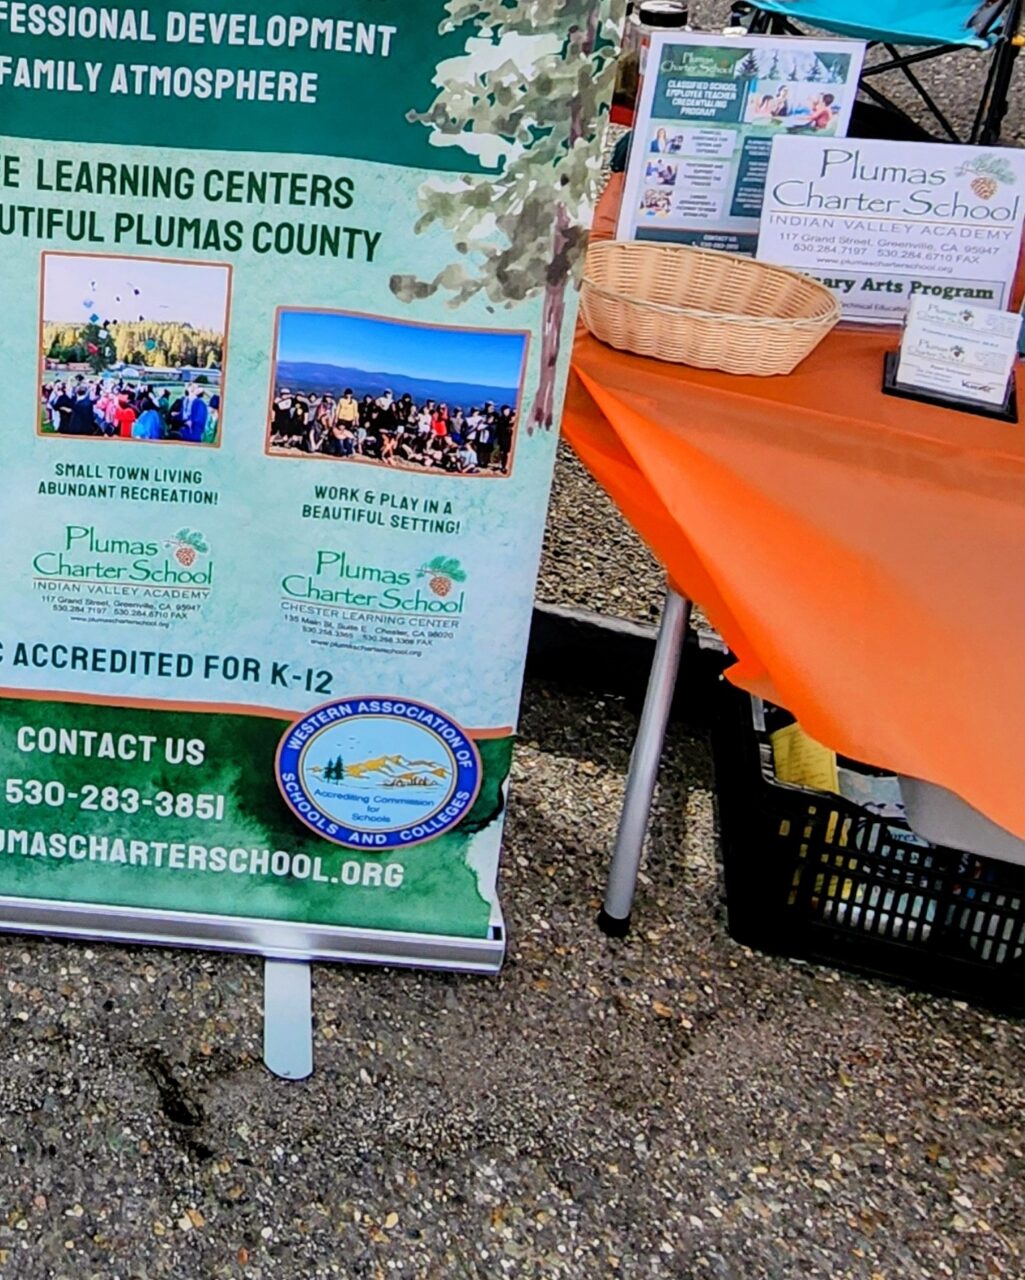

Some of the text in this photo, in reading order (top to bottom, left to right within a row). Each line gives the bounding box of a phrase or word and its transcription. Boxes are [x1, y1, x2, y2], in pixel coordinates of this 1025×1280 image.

[166, 12, 396, 57] DEVELOPMENT
[110, 63, 318, 103] ATMOSPHERE
[820, 149, 947, 186] Plumas
[36, 158, 195, 200] LEARNING
[203, 169, 355, 209] CENTERS
[773, 180, 901, 213] Charter
[903, 190, 1020, 220] School
[114, 213, 243, 252] PLUMAS
[252, 222, 382, 262] COUNTY
[770, 215, 1013, 240] INDIAN VALLEY ACADEMY
[801, 233, 835, 243] Grand
[941, 243, 958, 252] CA
[956, 255, 980, 264] FAX
[861, 278, 903, 293] Arts
[910, 281, 993, 300] Program
[55, 463, 202, 484] SMALL TOWN LIVING
[38, 482, 218, 505] ABUNDANT RECREATION!
[315, 485, 452, 514] WORK & PLAY IN A
[302, 505, 460, 534] BEAUTIFUL SETTING!
[66, 526, 158, 556] Plumas
[33, 553, 212, 584] Charter School
[316, 550, 410, 585] Plumas
[33, 582, 210, 600] INDIAN VALLEY ACADEMY
[282, 575, 464, 613] Charter School
[159, 603, 171, 611] CA
[281, 602, 459, 628] CHESTER LEARNING CENTER
[12, 644, 191, 681] ACCREDITED
[203, 655, 262, 684] FOR
[269, 663, 334, 695] K-12
[17, 726, 206, 765] CONTACT US
[287, 701, 473, 768] WESTERN ASSOCIATION OF
[5, 778, 225, 821] 530-283-3851
[282, 772, 470, 844] SCHOOLS AND COLLEGES
[367, 805, 380, 813] for
[352, 813, 391, 823] Schools
